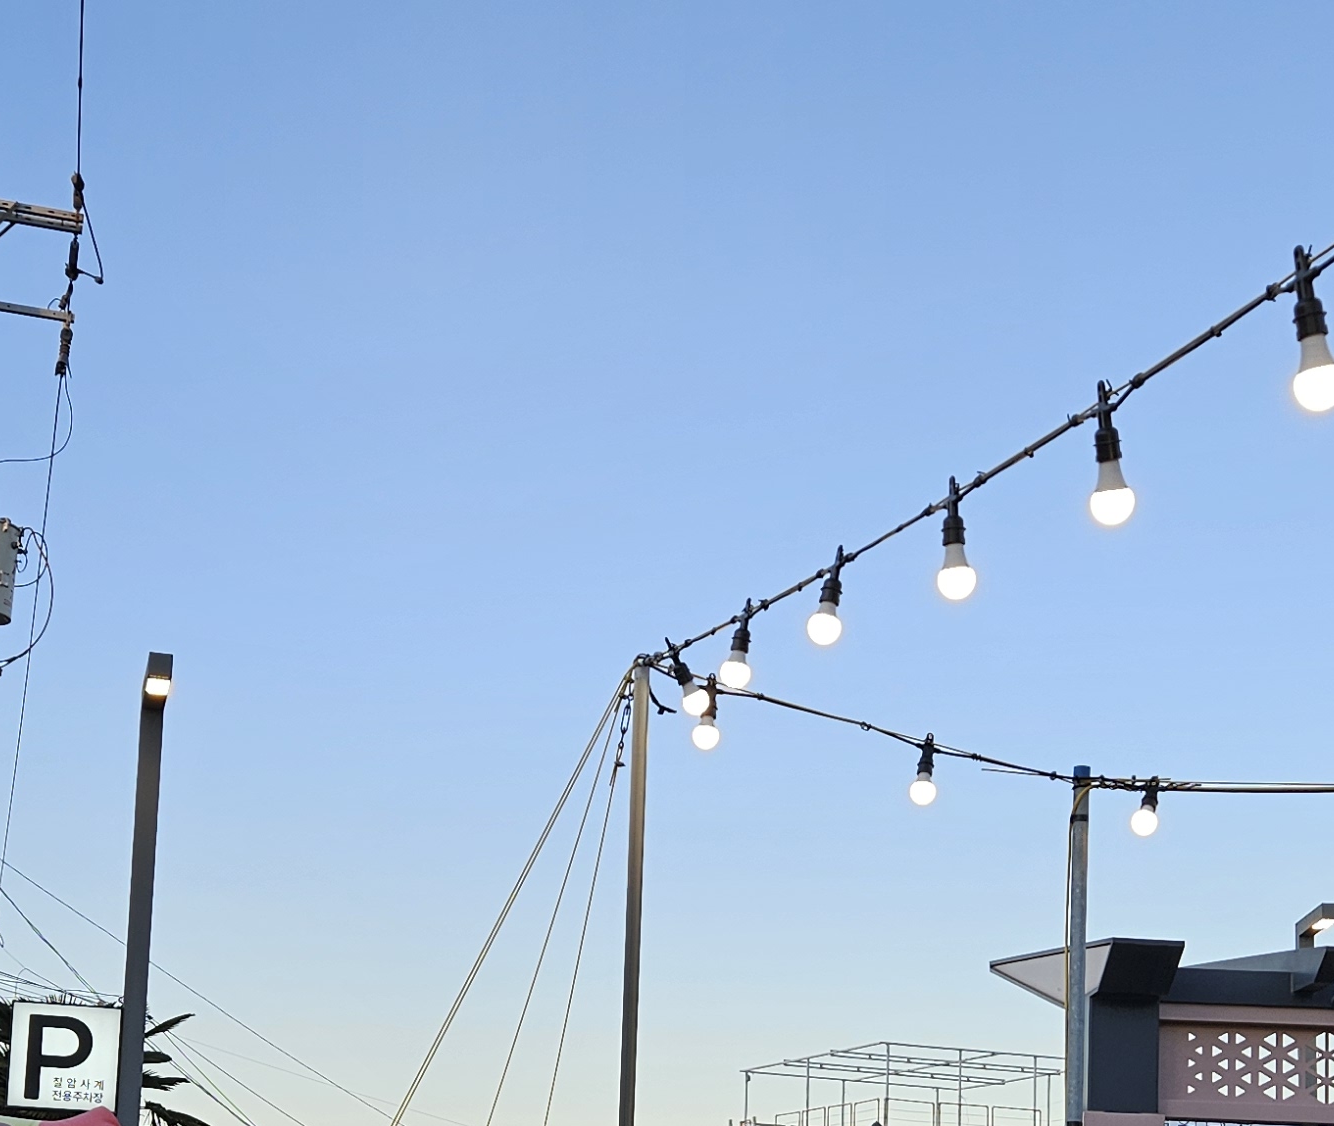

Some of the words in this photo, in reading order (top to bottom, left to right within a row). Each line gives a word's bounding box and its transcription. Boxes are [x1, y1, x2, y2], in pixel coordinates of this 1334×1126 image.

[23, 1013, 94, 1100] P
[52, 1077, 104, 1090] 칠암사계
[51, 1090, 103, 1104] 전용주차장
